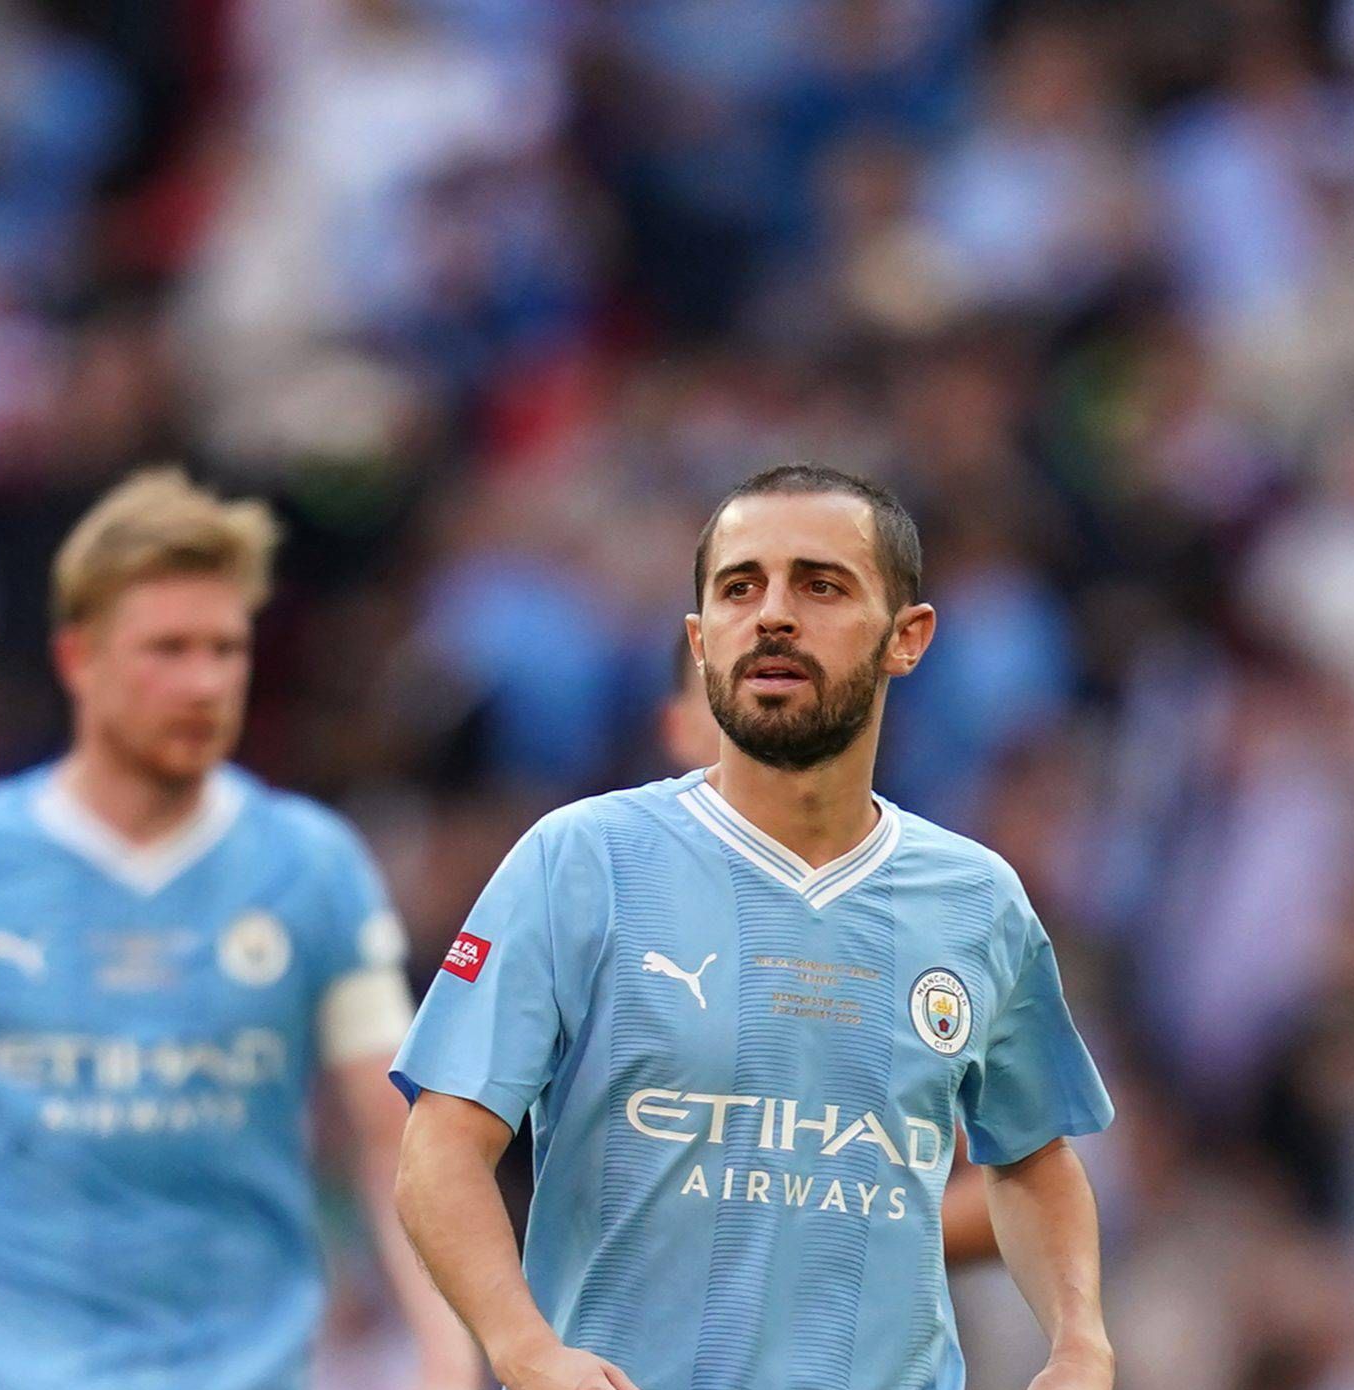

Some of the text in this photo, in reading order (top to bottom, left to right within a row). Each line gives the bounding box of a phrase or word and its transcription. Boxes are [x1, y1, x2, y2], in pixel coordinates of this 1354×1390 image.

[461, 941, 478, 957] FA
[916, 974, 968, 1007] MANCHESTER
[934, 1040, 953, 1051] CITY
[626, 1087, 942, 1171] ETIHAD
[680, 1164, 908, 1220] AIRWAYS
